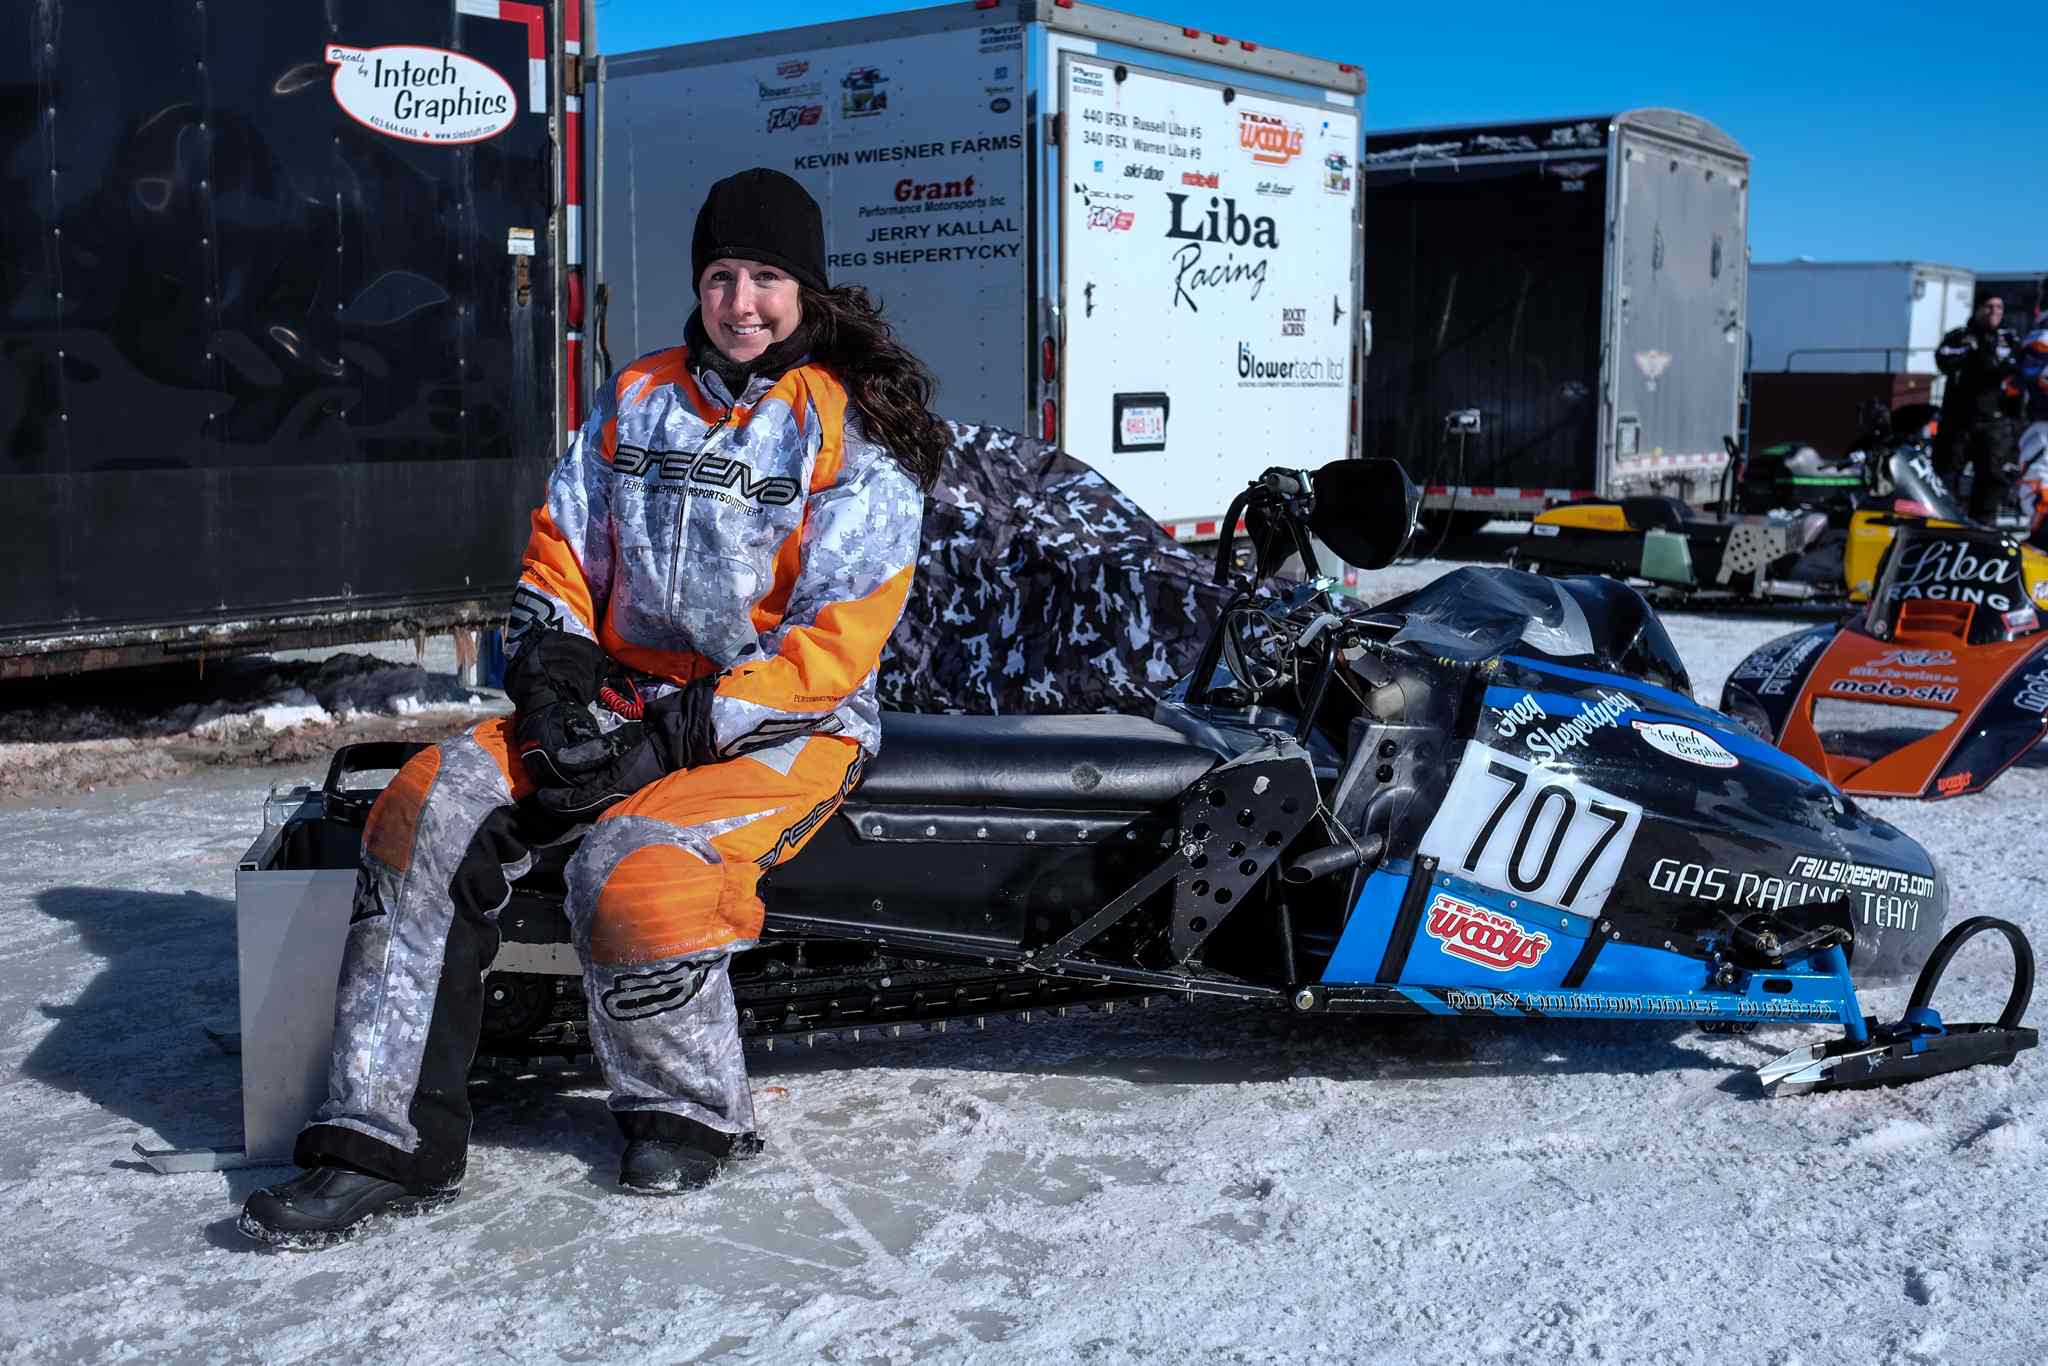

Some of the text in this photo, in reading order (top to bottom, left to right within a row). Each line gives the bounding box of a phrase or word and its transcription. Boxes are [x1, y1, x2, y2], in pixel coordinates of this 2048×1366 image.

[331, 48, 365, 63] Decals
[358, 65, 368, 77] by
[374, 55, 457, 88] Intech
[394, 86, 507, 125] Graphics
[1240, 112, 1282, 125] TEAM
[1083, 108, 1102, 124] 440
[1133, 116, 1166, 134] Russell
[1168, 121, 1188, 138] Liba
[794, 134, 1021, 170] KEVIN WIESNER FARMS
[1083, 130, 1102, 146] 340
[1133, 138, 1166, 155] Warren
[1168, 143, 1187, 159] Liba
[895, 175, 975, 201] Grant
[858, 195, 1006, 218] Performance Motorsports Inc
[1165, 191, 1279, 249] Liba
[866, 217, 1018, 243] JERRY KALLAL
[827, 243, 1020, 268] REG SHEPERTYCKY
[1172, 242, 1268, 313] Racing
[1897, 541, 2018, 585] Liba
[1887, 583, 2010, 611] RACING
[1490, 693, 1547, 738] Greg
[1461, 760, 1629, 908] 707
[1649, 858, 1730, 901] GAS
[1861, 891, 1919, 931] TEAM
[1439, 898, 1512, 929] TEAM
[1447, 992, 1520, 1010] ROCKY
